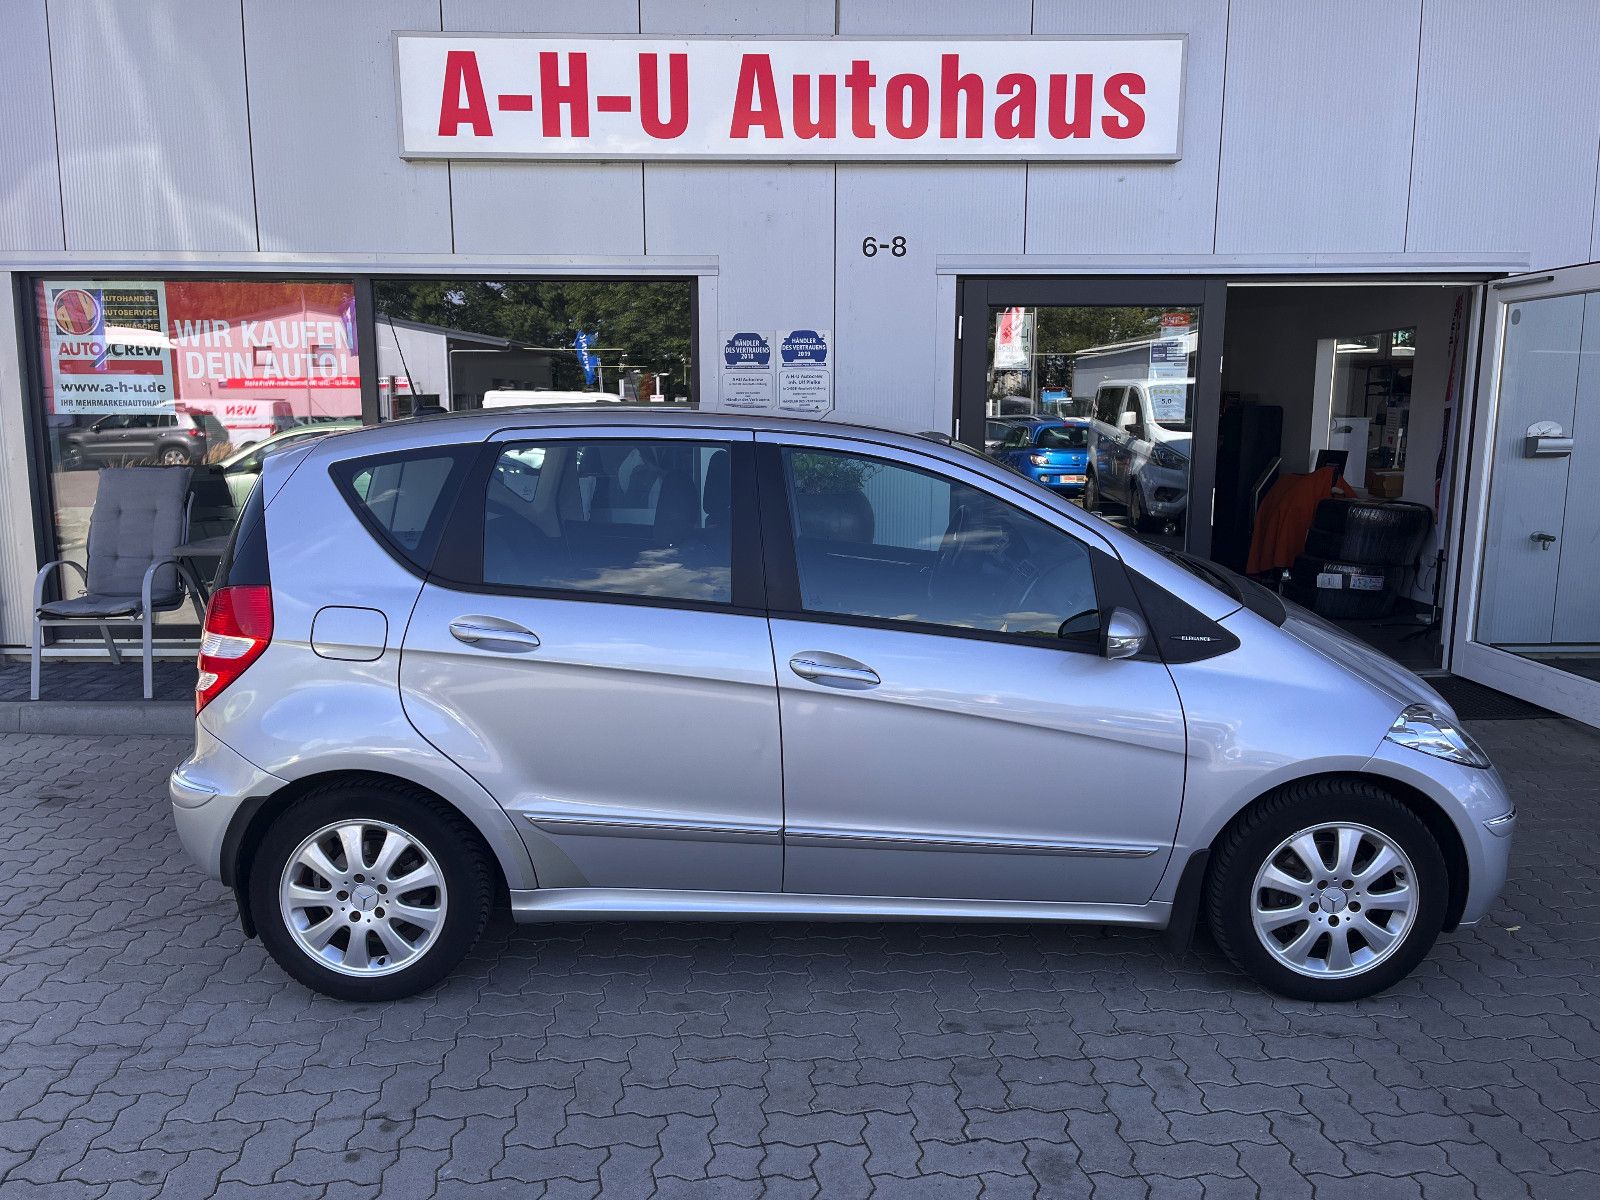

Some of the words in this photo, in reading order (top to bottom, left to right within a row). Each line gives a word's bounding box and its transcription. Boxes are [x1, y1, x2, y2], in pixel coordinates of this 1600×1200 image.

[438, 49, 690, 138] A-H-U
[730, 53, 1147, 140] Autohaus
[862, 235, 907, 258] 6-8
[174, 319, 232, 347] WIR
[240, 320, 354, 349] KAUFEN
[59, 342, 103, 356] AUTO
[111, 343, 161, 357] CREW
[725, 346, 735, 354] DES
[736, 346, 770, 354] VERTRAUENS
[734, 339, 760, 347] HÄNDLER
[187, 352, 255, 379] DEIN
[263, 352, 348, 380] AUTO!
[61, 382, 167, 393] www.a-h-u.de
[61, 399, 74, 407] IHR
